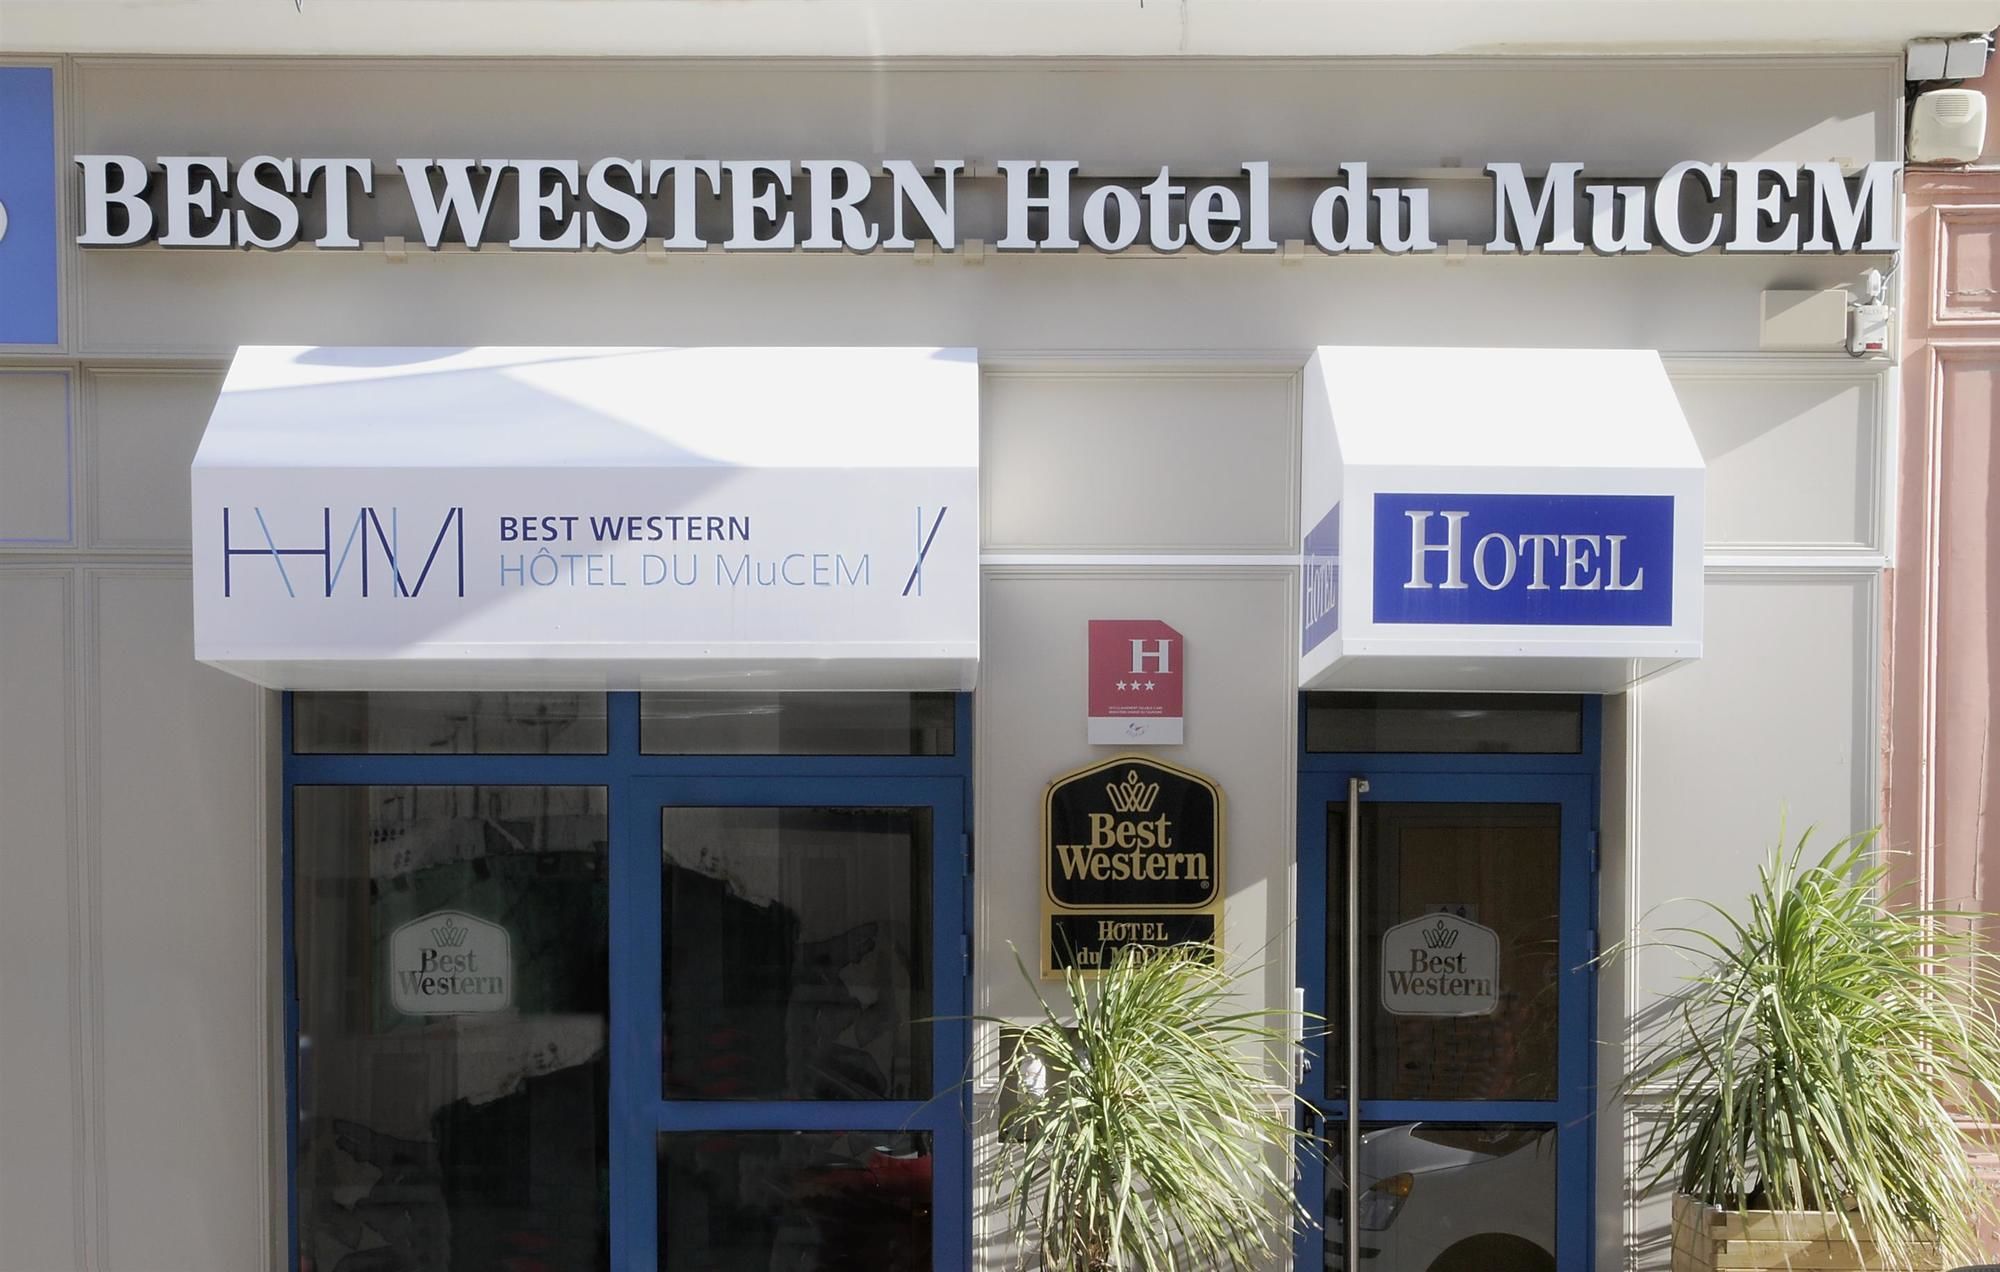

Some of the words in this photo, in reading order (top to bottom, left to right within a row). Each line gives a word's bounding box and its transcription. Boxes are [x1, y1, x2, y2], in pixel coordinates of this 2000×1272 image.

[74, 155, 375, 251] BEST
[396, 157, 966, 254] WESTERN
[996, 160, 1279, 255] Hotel
[1310, 161, 1438, 255] du
[1484, 160, 1902, 256] MuCEM
[499, 516, 579, 541] BEST
[590, 516, 751, 541] WESTERN
[1403, 510, 1644, 591] HOTEL
[499, 547, 627, 586] HÔTEL
[641, 553, 698, 586] DU
[715, 553, 871, 586] MuCEM
[1128, 638, 1174, 674] H
[1088, 812, 1172, 849] Best
[1056, 844, 1210, 881] Western
[1097, 920, 1169, 941] HOTEL
[419, 947, 479, 973] Best
[1076, 946, 1101, 965] du
[1409, 948, 1468, 974] Best
[398, 966, 504, 996] Western
[1387, 969, 1492, 996] Western
